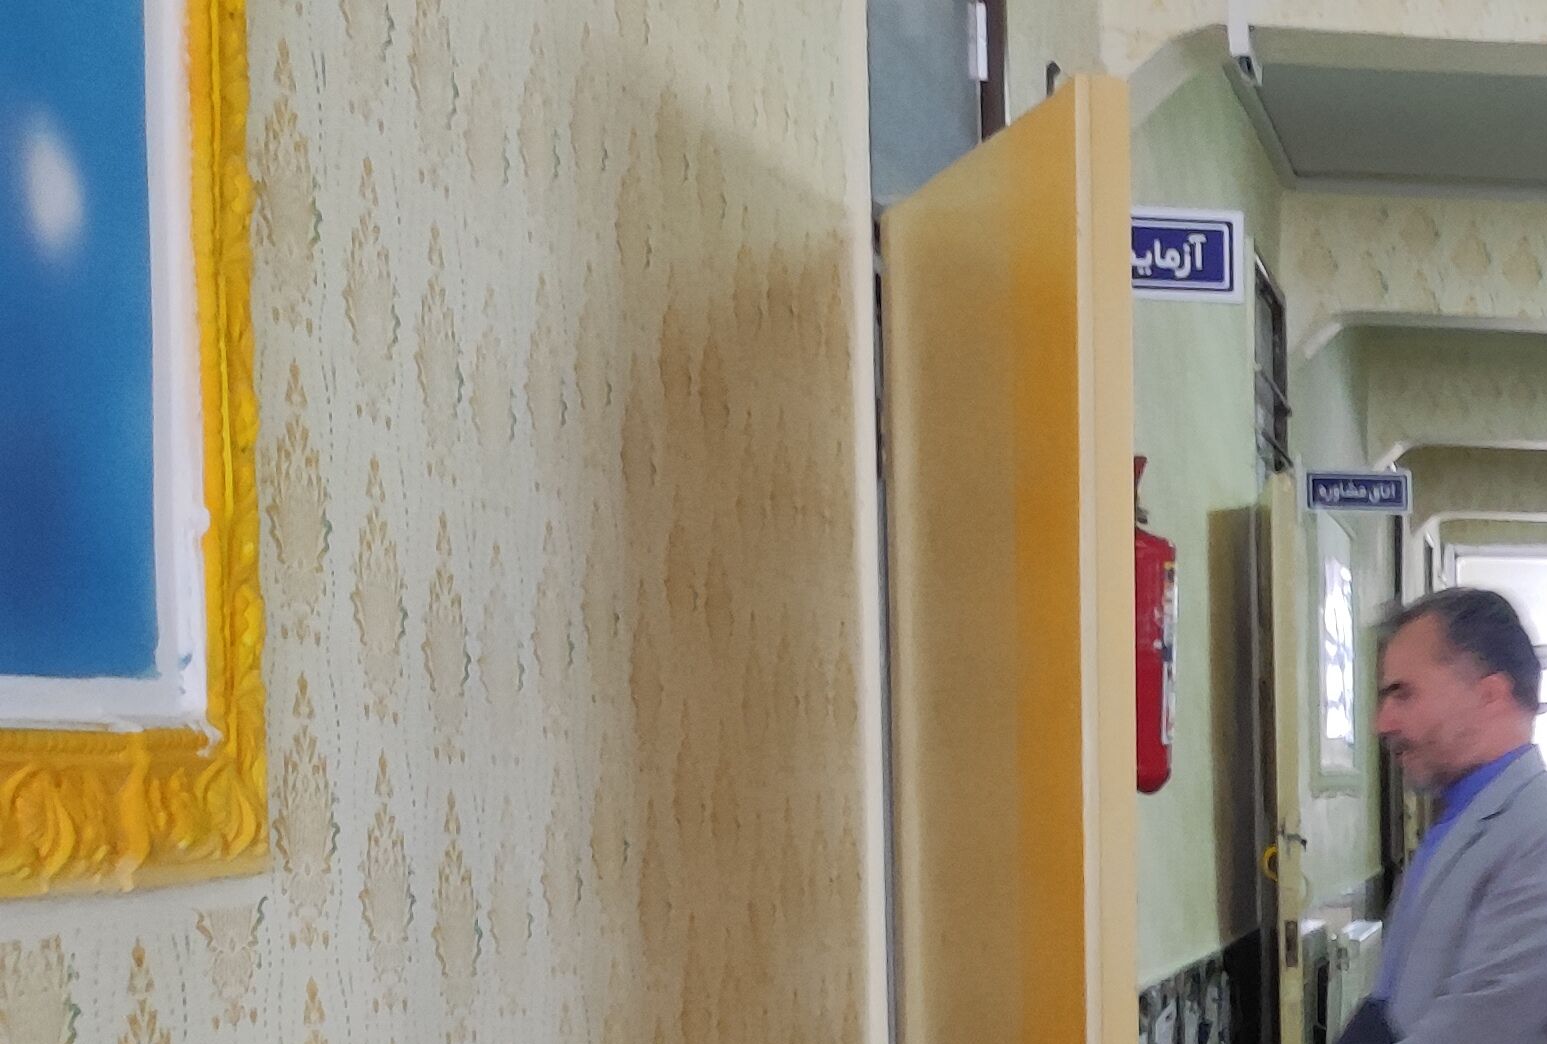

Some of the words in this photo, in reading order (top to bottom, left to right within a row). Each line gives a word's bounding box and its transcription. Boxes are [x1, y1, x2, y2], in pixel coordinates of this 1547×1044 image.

[1131, 233, 1207, 279] آزمای
[1319, 479, 1367, 502] مشاوره
[1368, 482, 1396, 503] اتاق
